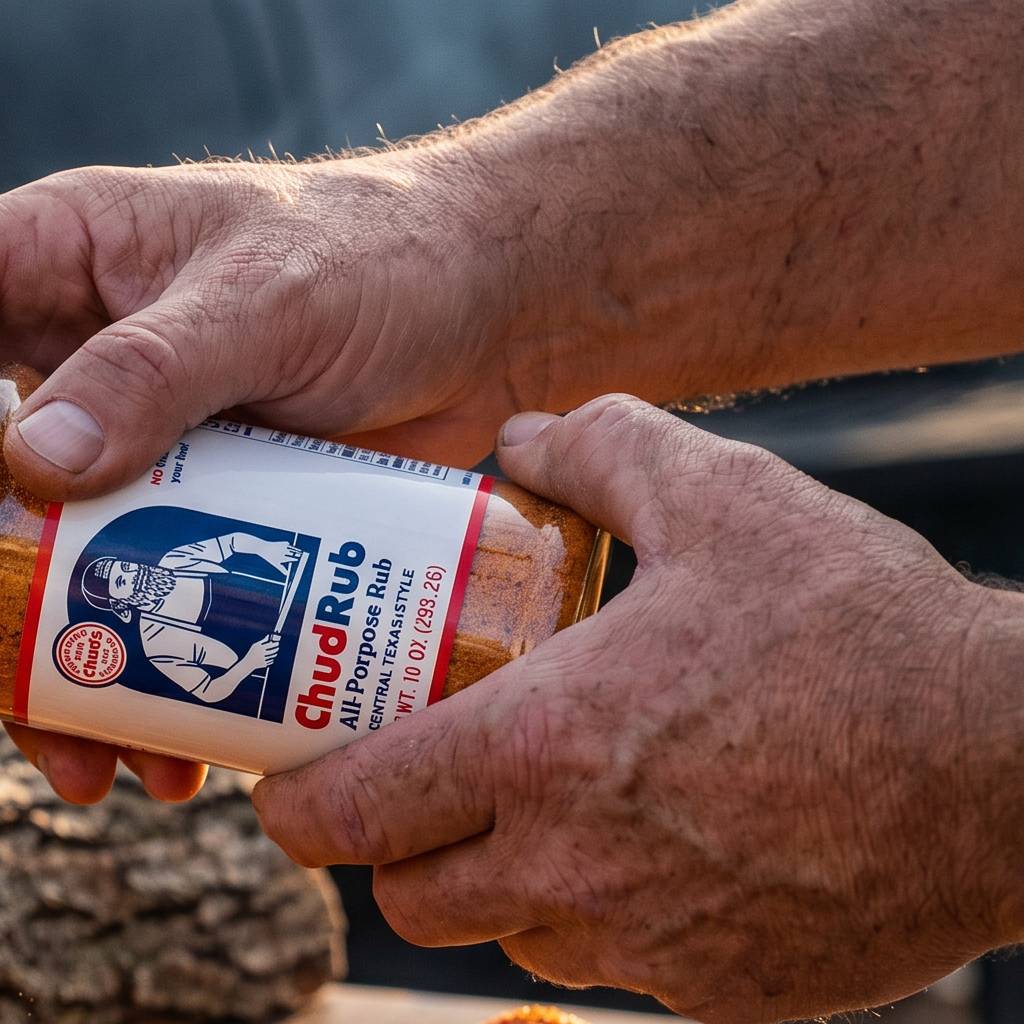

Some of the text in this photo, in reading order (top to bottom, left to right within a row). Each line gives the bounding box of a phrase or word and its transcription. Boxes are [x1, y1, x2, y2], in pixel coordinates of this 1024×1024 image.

[150, 469, 164, 486] NO
[171, 461, 184, 484] your
[366, 558, 392, 599] Rub
[294, 541, 366, 730] ChudRub
[403, 666, 422, 683] 10
[368, 670, 393, 731] CENTRAL
